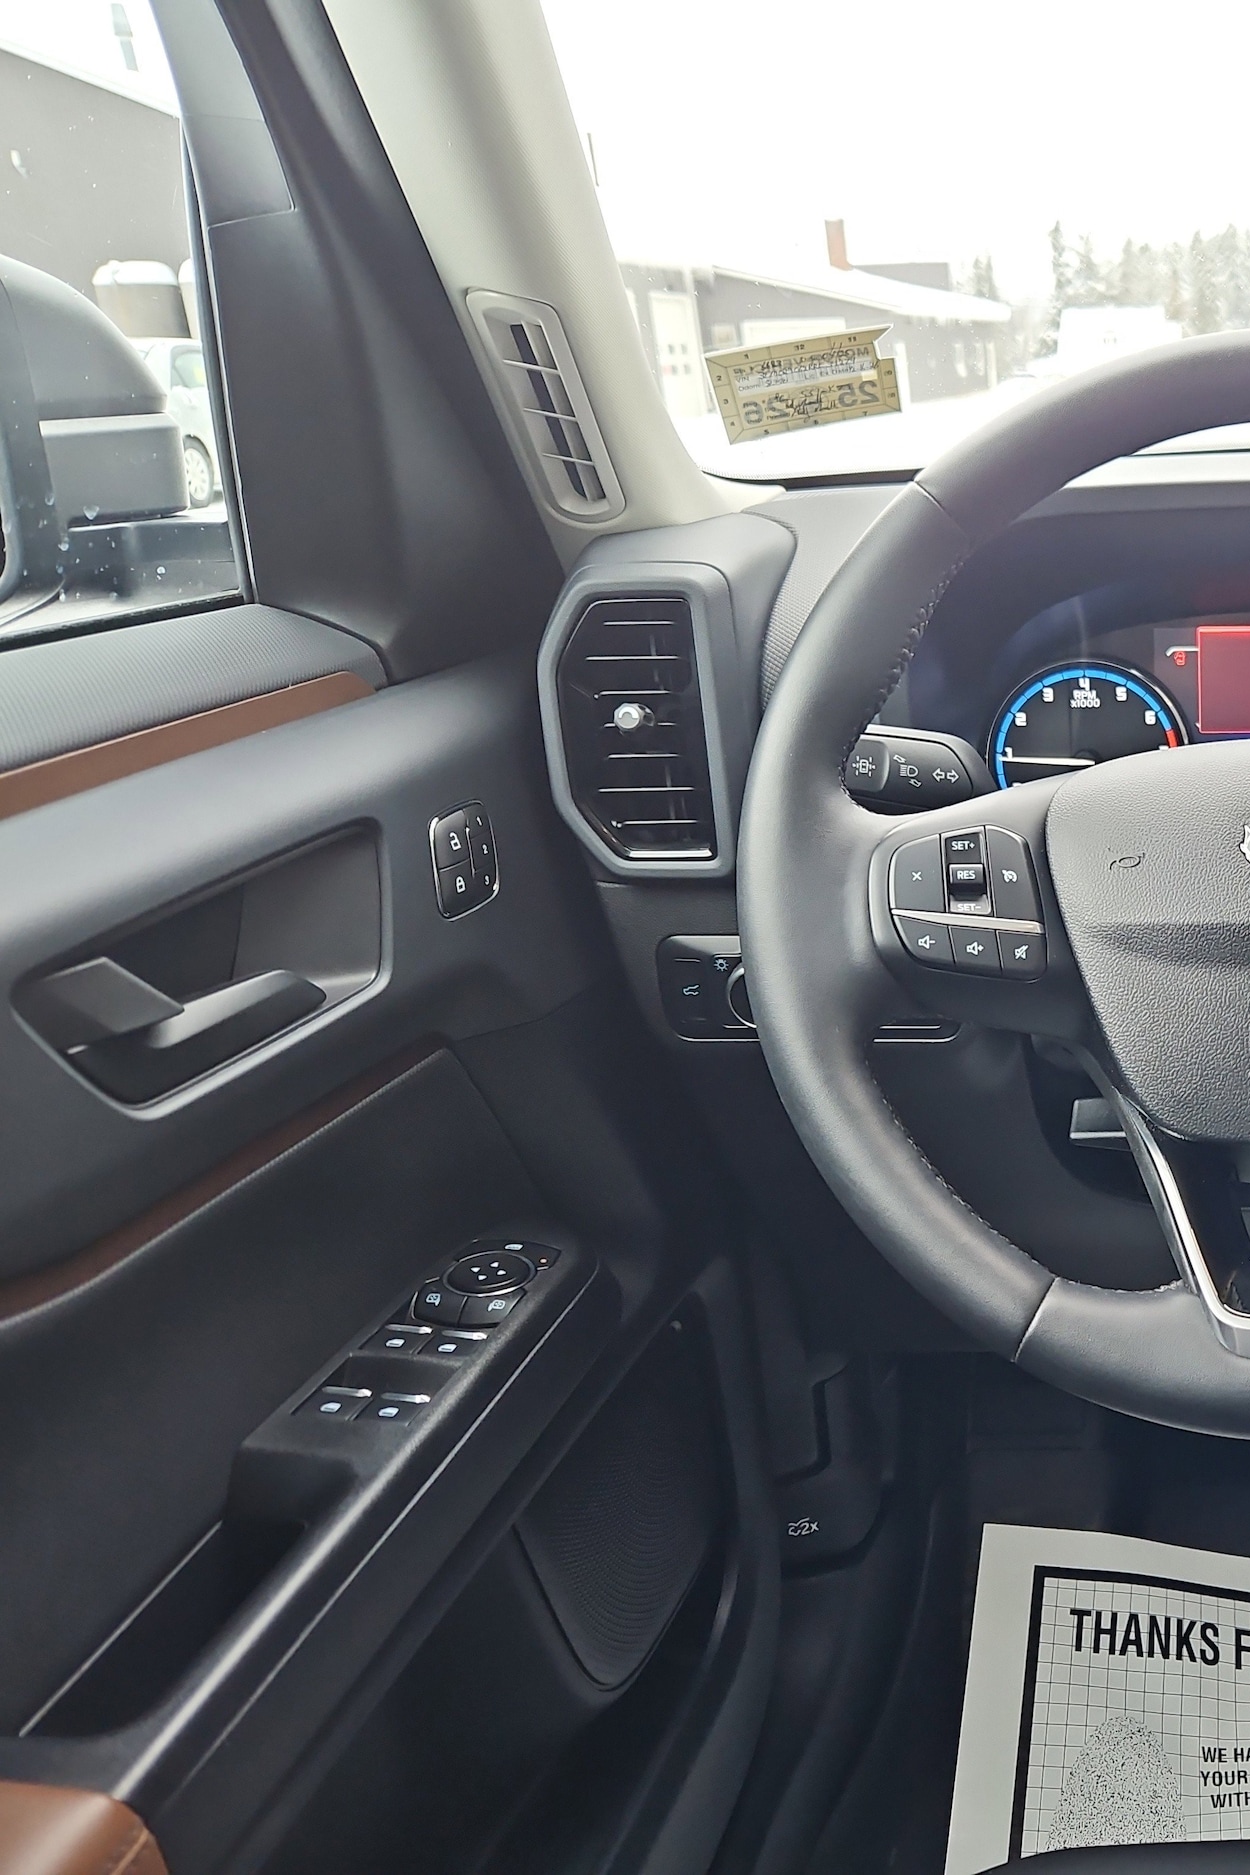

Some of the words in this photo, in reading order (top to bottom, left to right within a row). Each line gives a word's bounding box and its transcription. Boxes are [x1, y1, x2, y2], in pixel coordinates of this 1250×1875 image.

[1078, 677, 1091, 692] 4
[1042, 687, 1054, 702] 3
[1073, 690, 1097, 700] RPM
[1115, 687, 1127, 702] 5
[1015, 712, 1027, 727] 2
[1144, 710, 1156, 725] 6
[956, 870, 976, 880] RES
[1070, 1608, 1220, 1666] THANKS
[1202, 1746, 1228, 1763] WE
[1200, 1769, 1248, 1787] YOUR
